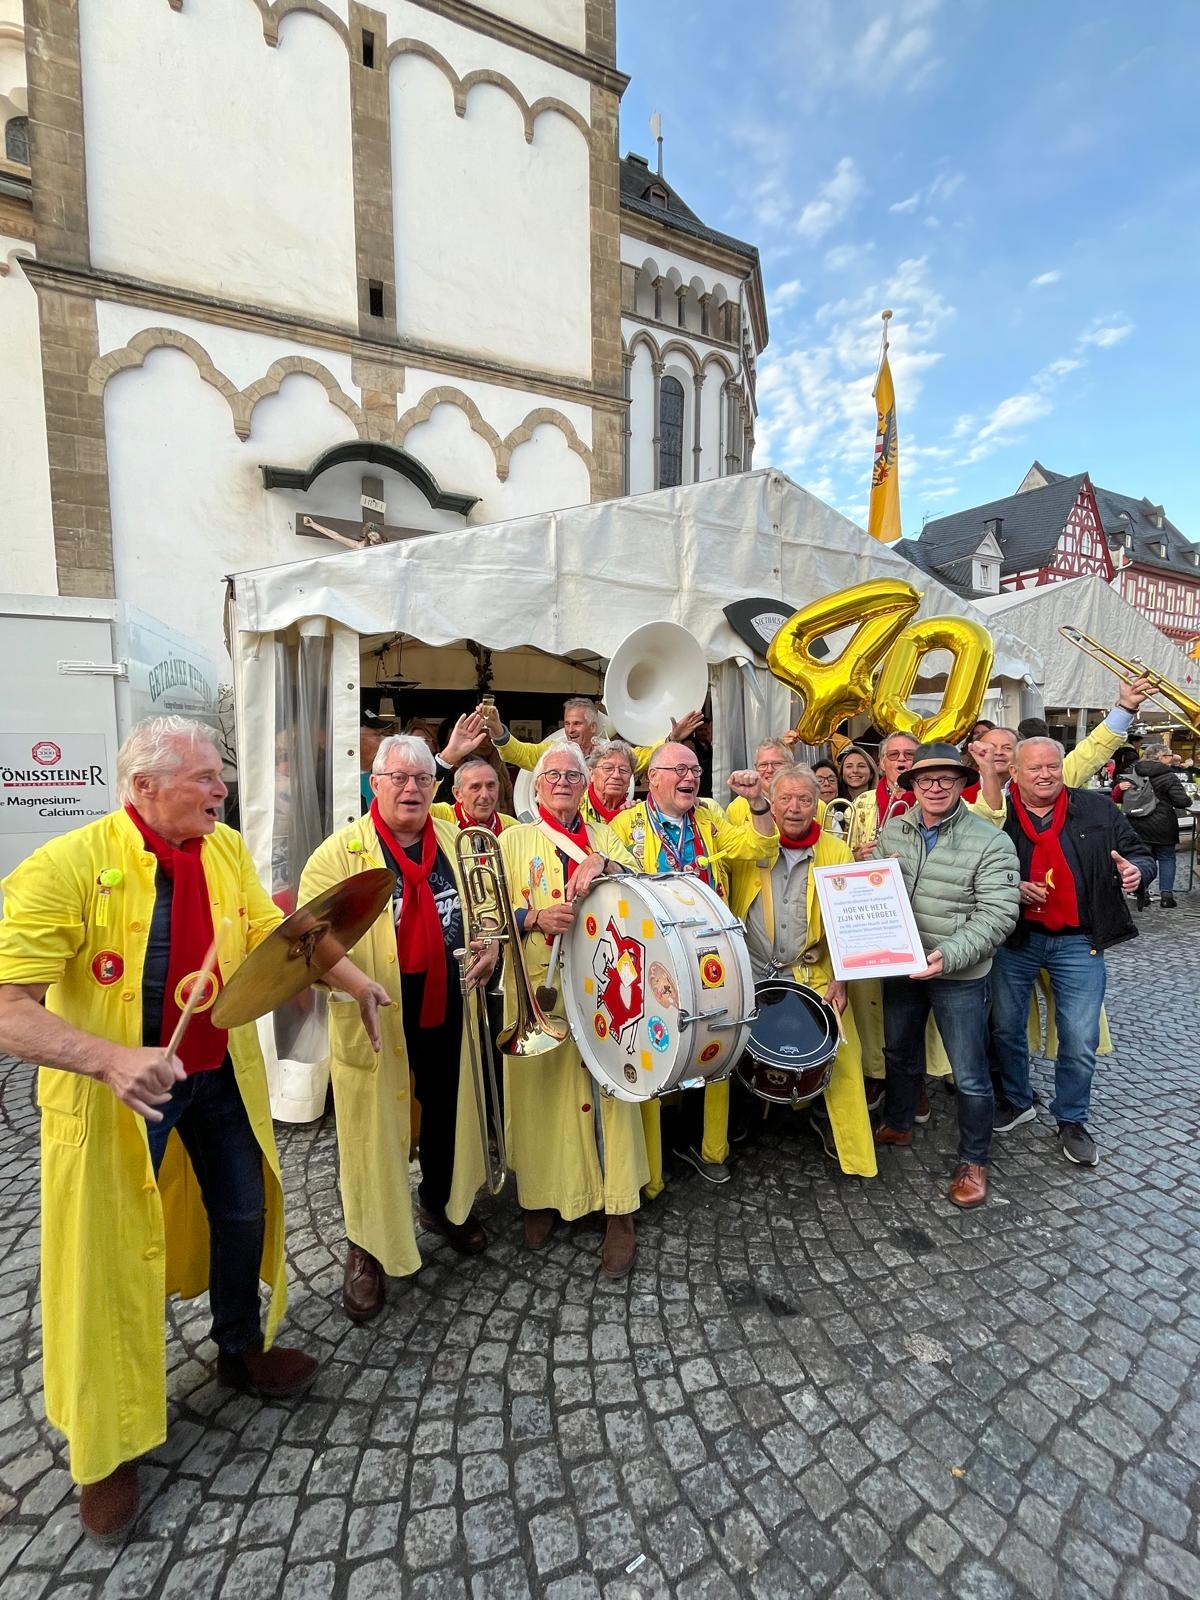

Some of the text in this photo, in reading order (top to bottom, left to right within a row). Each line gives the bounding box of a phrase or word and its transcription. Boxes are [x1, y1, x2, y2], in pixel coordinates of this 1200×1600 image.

[0, 765, 106, 786] ÖNISSTEINER
[7, 796, 81, 807] Magnesium-
[38, 808, 85, 817] Calcium
[842, 903, 888, 914] HOE WE HETE
[854, 913, 865, 921] WE
[866, 910, 897, 920] VERGETE
